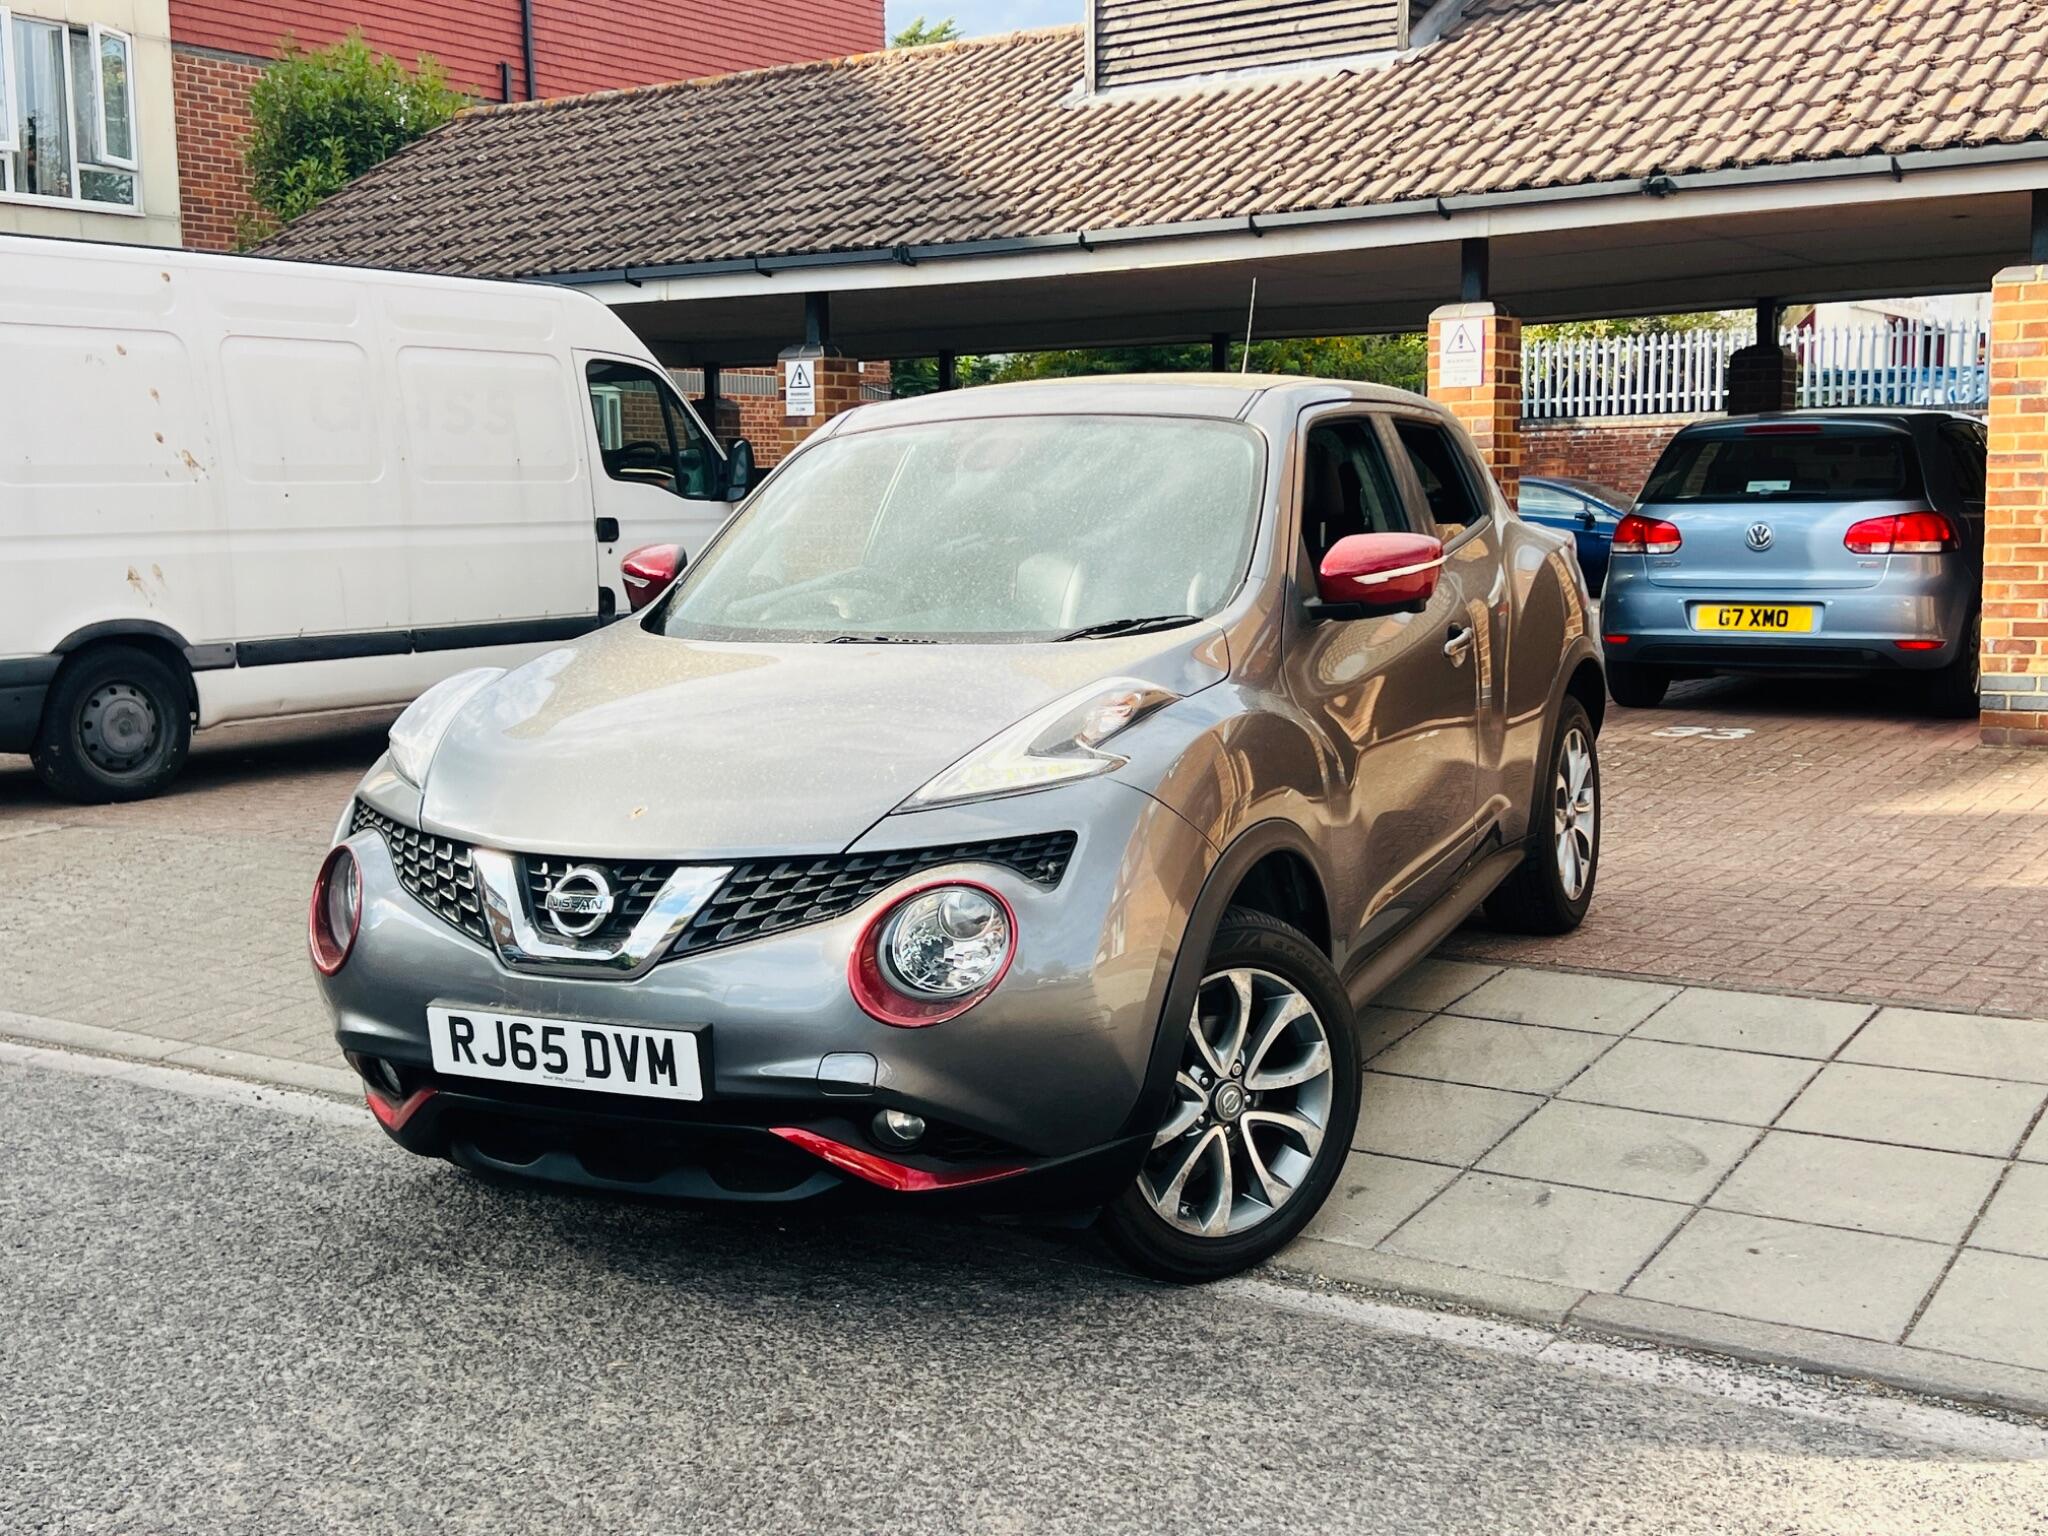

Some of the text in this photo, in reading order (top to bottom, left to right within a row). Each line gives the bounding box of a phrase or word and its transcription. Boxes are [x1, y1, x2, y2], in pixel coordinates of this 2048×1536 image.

[1718, 608, 1789, 628] G7 XMO
[547, 893, 604, 911] NISSAN
[448, 1015, 678, 1087] RJ65 DVM
